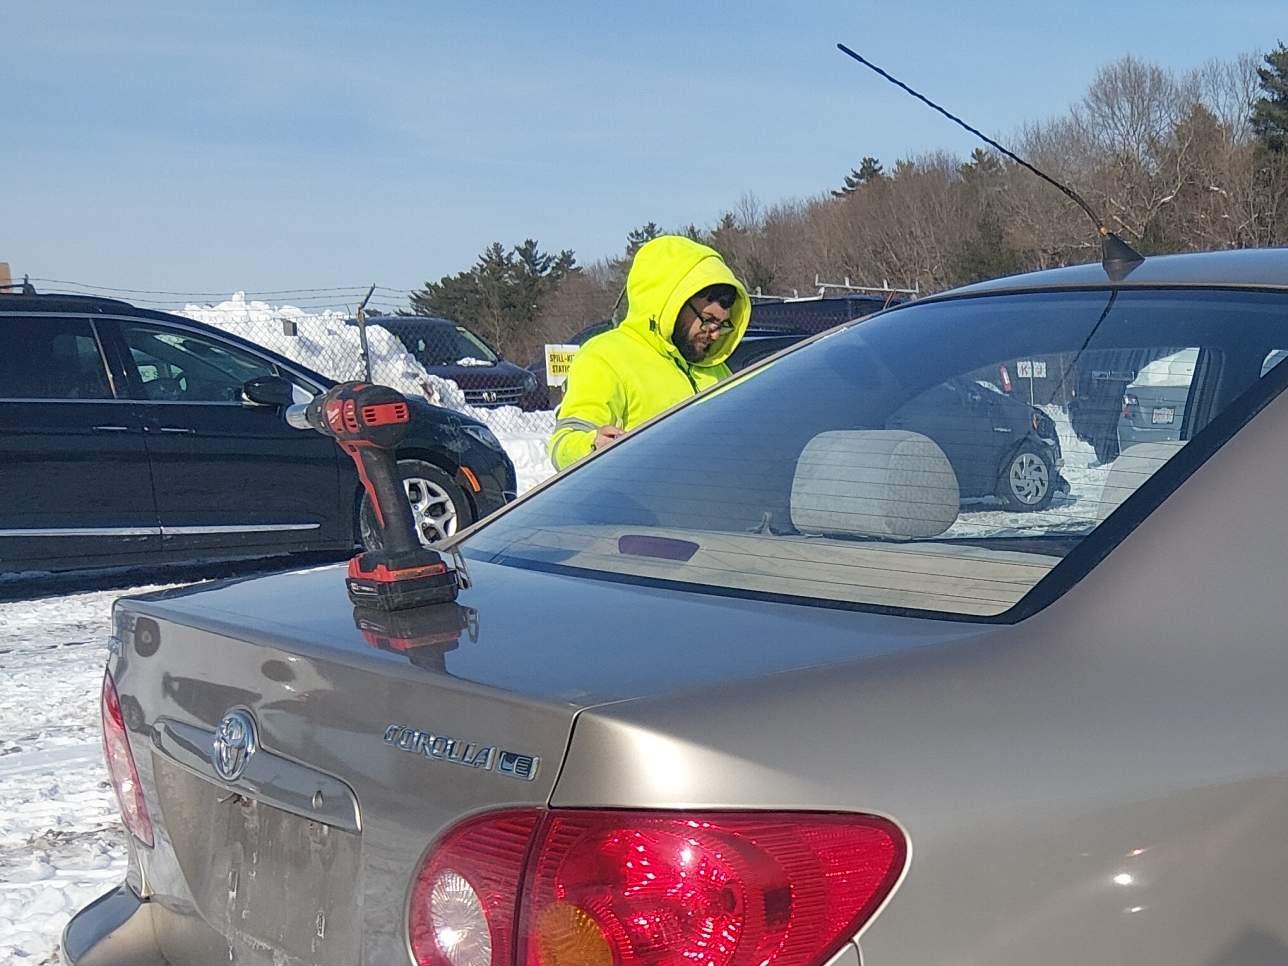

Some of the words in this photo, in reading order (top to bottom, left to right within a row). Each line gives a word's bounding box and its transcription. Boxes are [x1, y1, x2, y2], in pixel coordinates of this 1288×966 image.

[550, 353, 575, 363] SPILL-KI
[384, 724, 496, 771] COROLLA
[500, 751, 536, 780] LE
